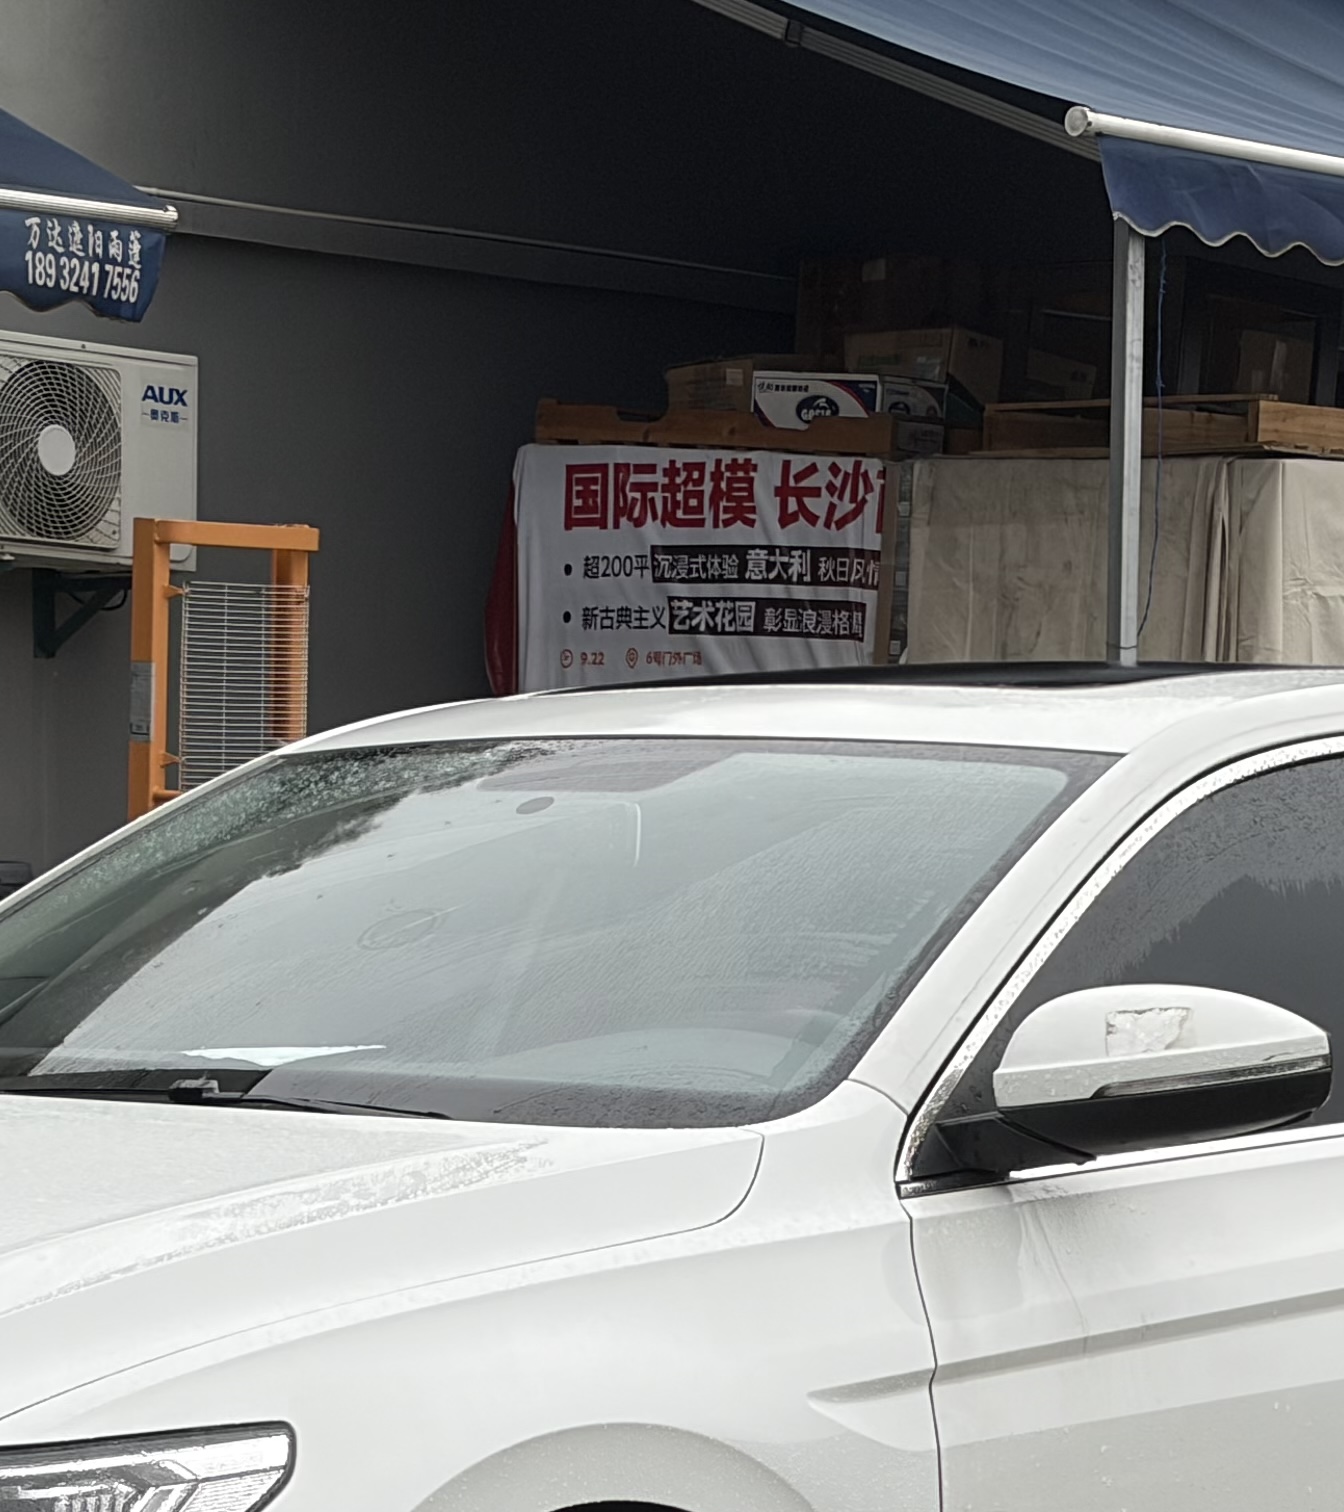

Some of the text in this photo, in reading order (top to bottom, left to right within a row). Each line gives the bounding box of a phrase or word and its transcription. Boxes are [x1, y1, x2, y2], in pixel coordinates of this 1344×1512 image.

[24, 250, 141, 303] 189 3241 7556
[141, 385, 188, 407] AUX
[563, 457, 758, 531] 国际超模
[745, 548, 811, 583] 意大利
[581, 604, 666, 631] 新古典主义
[669, 599, 756, 633] 艺术花园
[580, 651, 605, 666] 9.22
